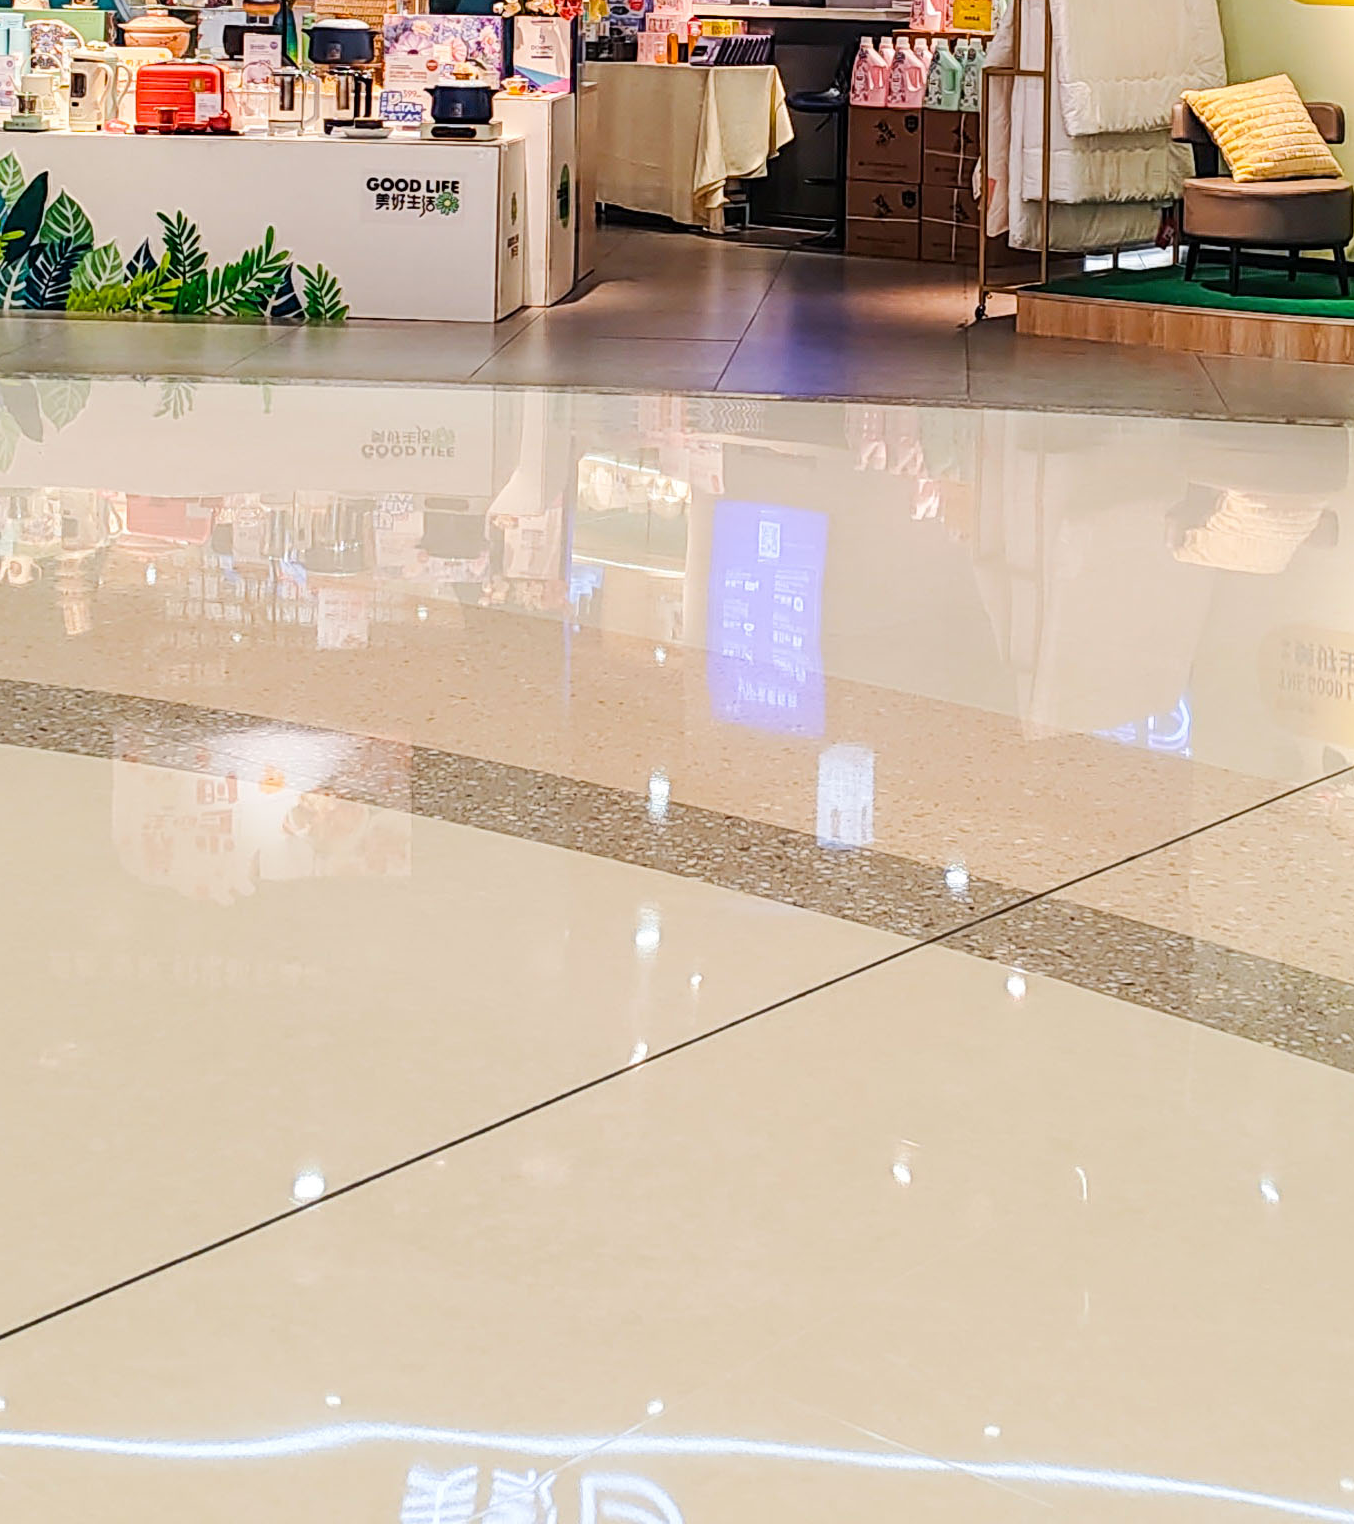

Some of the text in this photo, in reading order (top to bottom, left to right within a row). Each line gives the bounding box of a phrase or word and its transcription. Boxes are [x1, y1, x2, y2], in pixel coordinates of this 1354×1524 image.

[366, 177, 460, 194] GOOD LIFE
[375, 193, 437, 218] 美好生活
